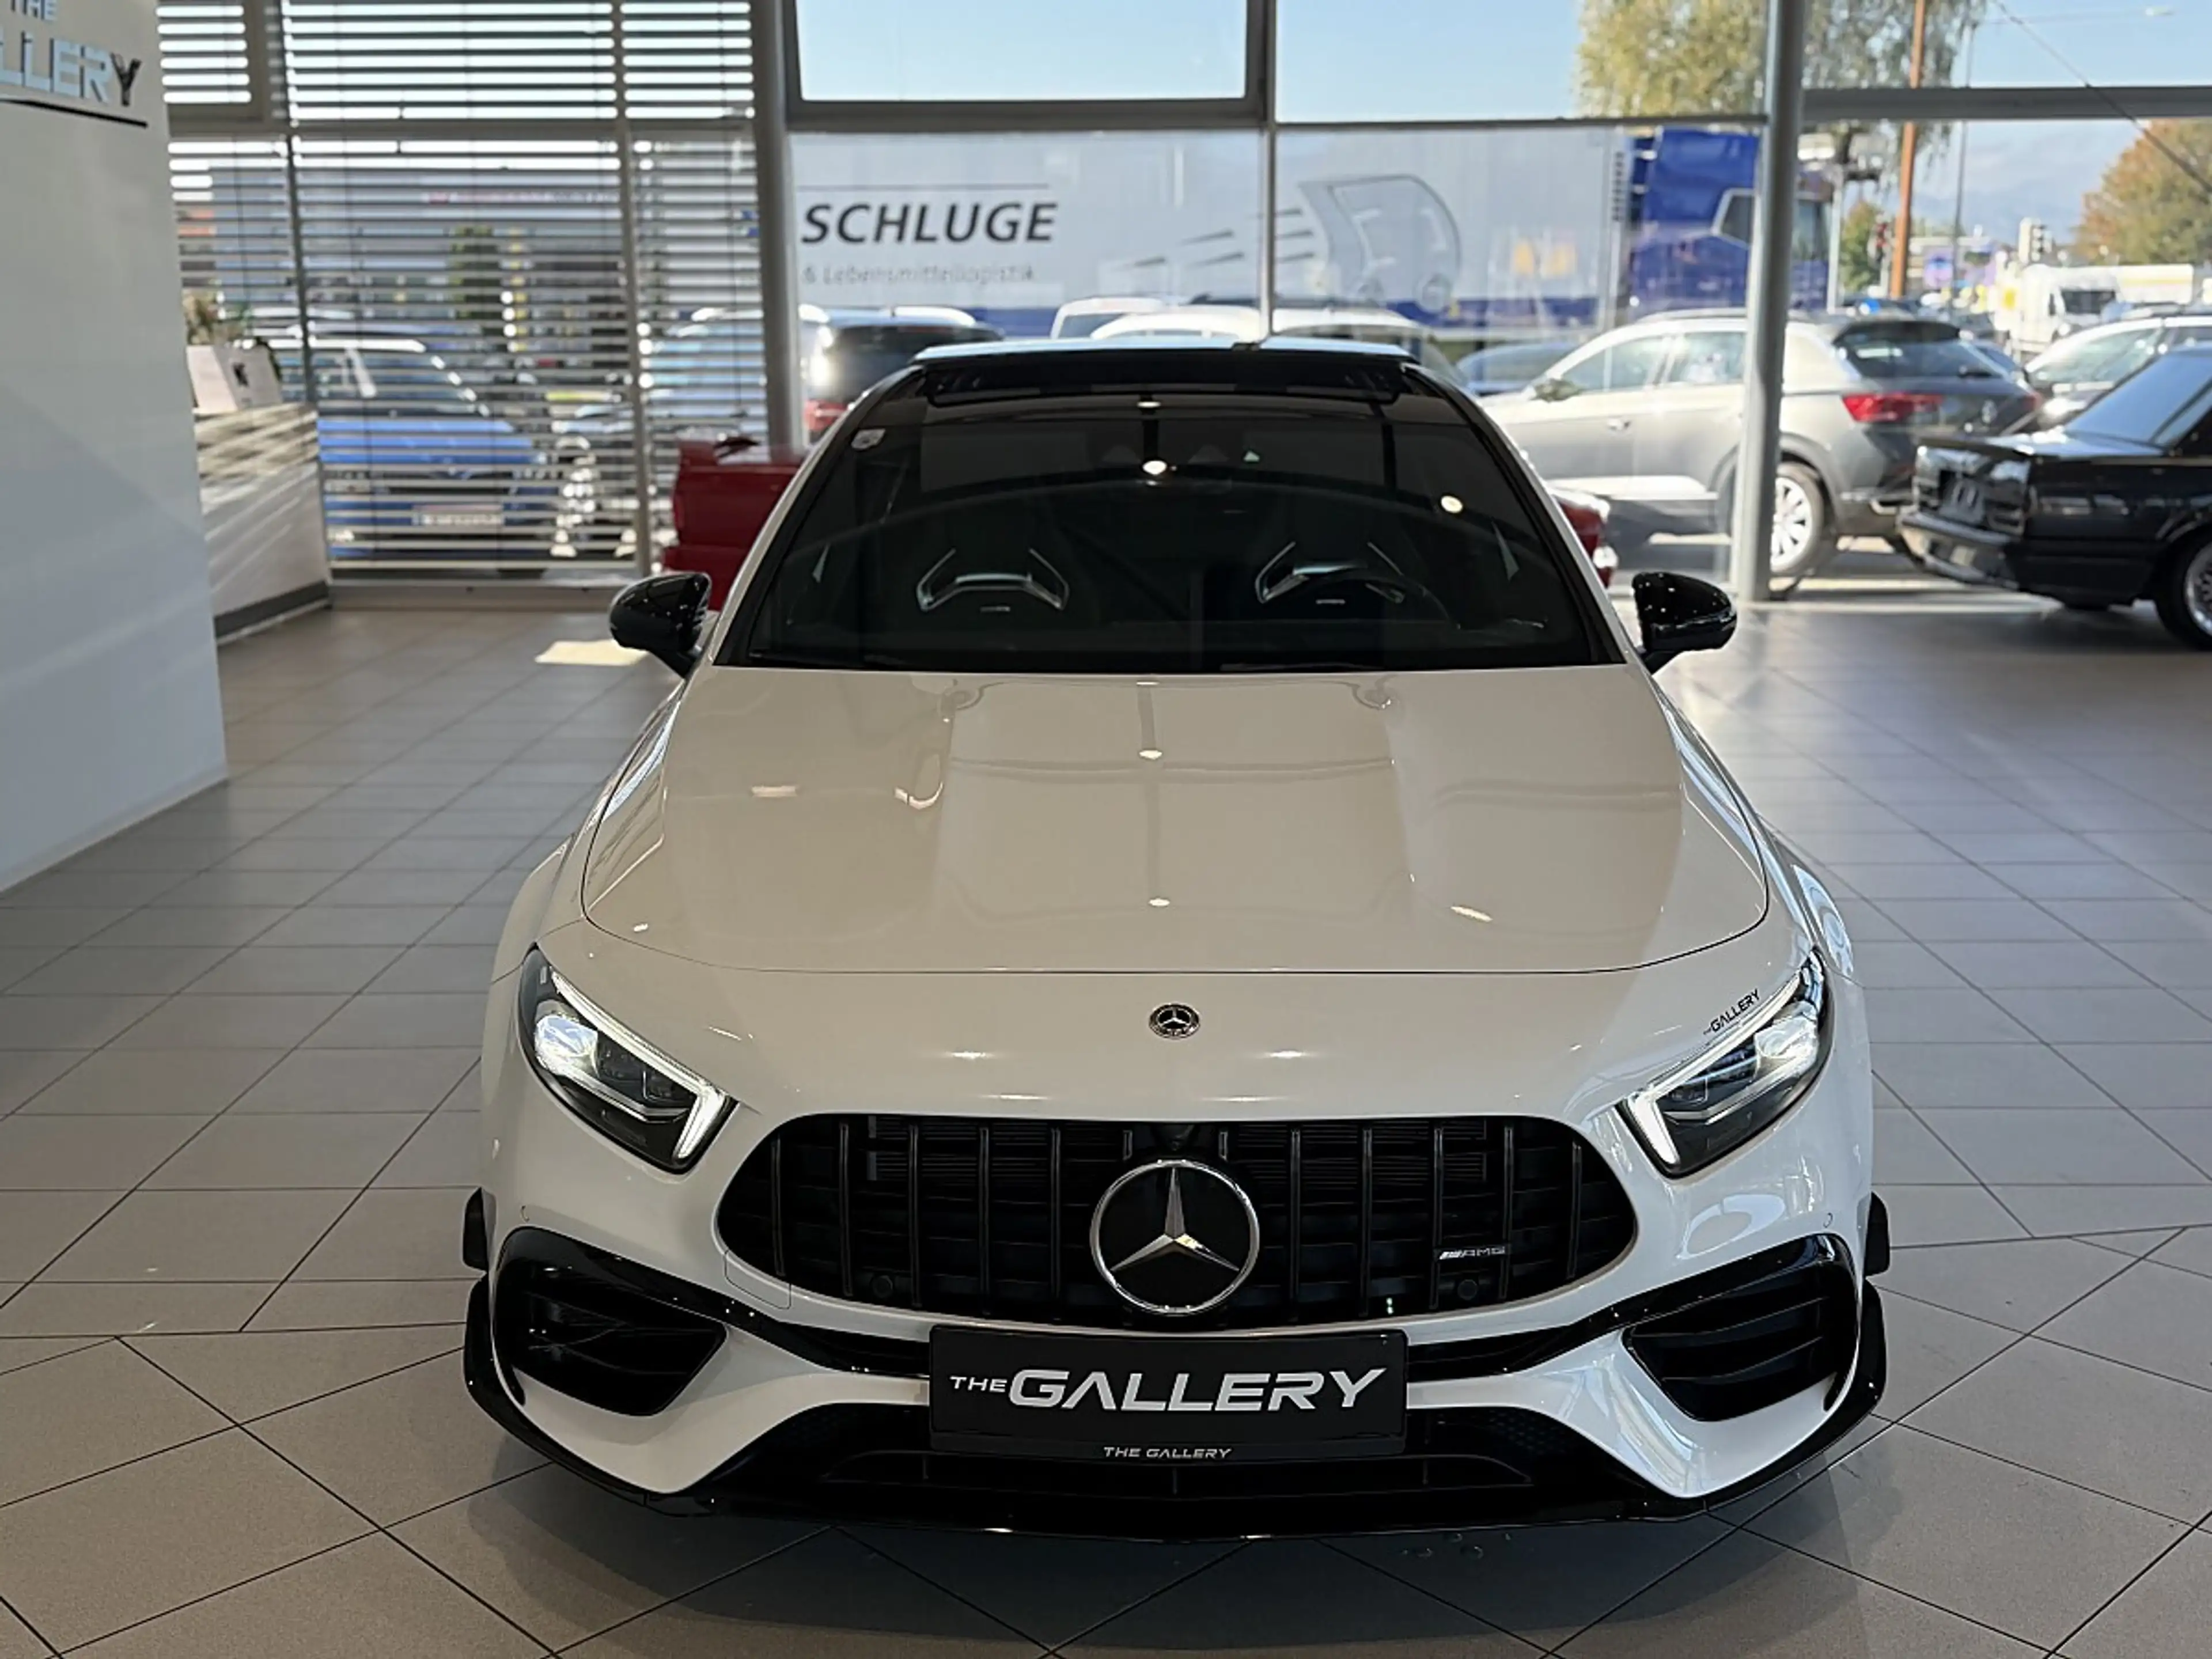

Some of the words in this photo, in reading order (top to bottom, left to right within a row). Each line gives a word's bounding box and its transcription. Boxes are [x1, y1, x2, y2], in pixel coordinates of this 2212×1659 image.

[801, 202, 1058, 244] SCHLUGE
[1710, 988, 1759, 1032] GALLERY
[950, 1375, 1007, 1393] THE
[1009, 1368, 1387, 1411] GALLERY
[1104, 1446, 1140, 1458] THE
[1146, 1448, 1232, 1459] GALLERY
